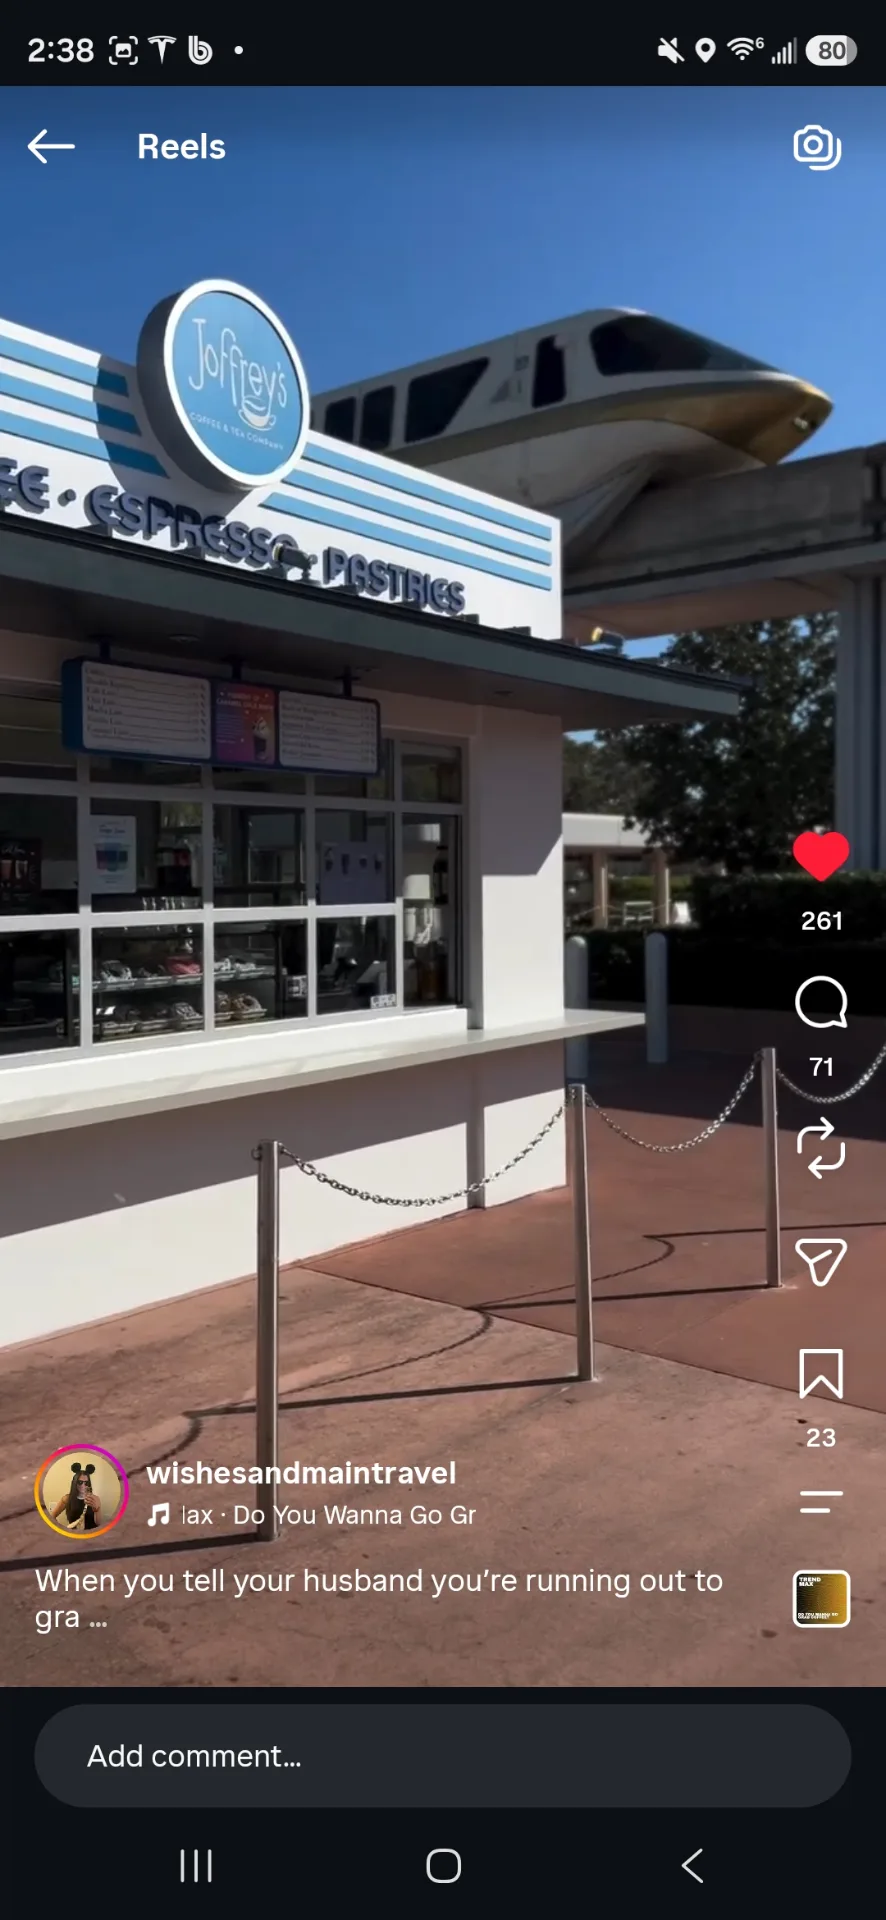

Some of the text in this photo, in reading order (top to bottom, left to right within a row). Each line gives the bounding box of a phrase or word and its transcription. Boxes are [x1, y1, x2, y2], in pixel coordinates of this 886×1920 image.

[188, 318, 288, 412] Joffrey's
[189, 411, 284, 451] COFFEE & TEA COMPANY
[323, 546, 466, 616] PASTRIES
